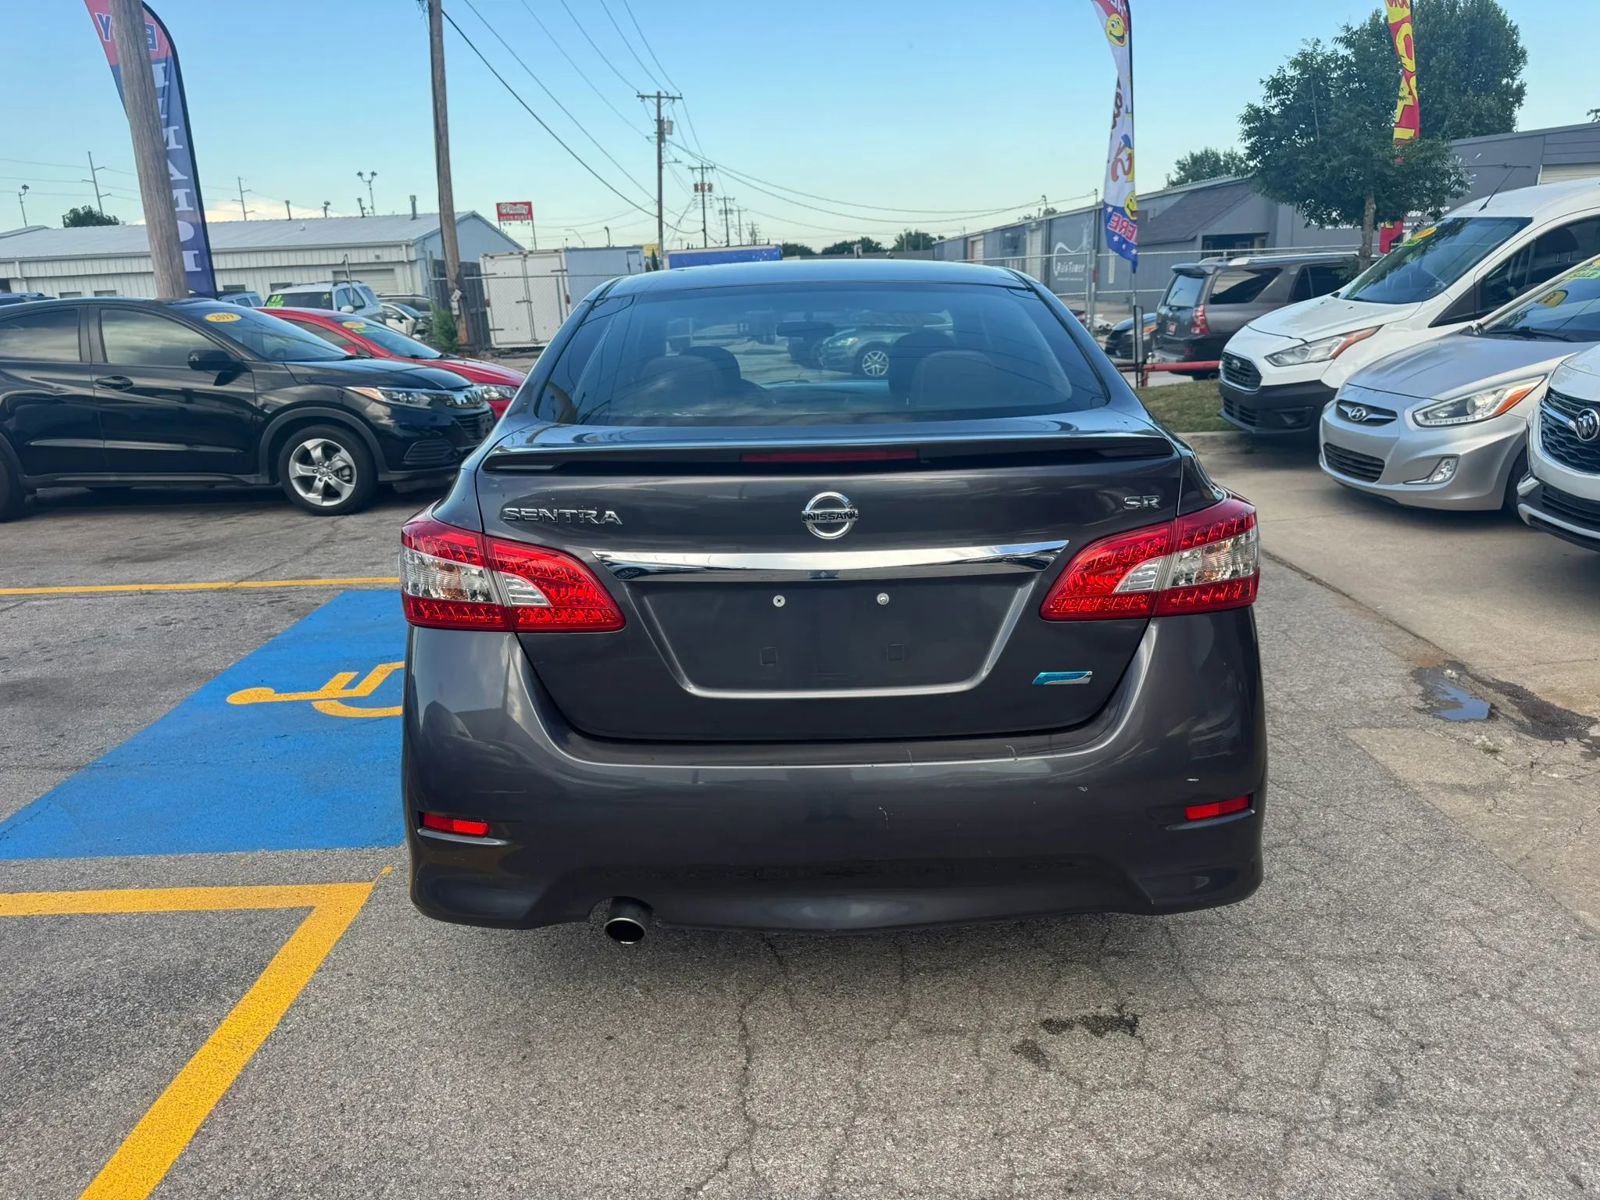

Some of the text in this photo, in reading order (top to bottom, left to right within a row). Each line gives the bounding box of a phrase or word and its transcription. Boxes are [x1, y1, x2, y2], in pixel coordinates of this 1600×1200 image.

[1123, 495, 1162, 510] SR
[502, 507, 624, 526] SENTRA
[806, 511, 857, 522] NISSAN
